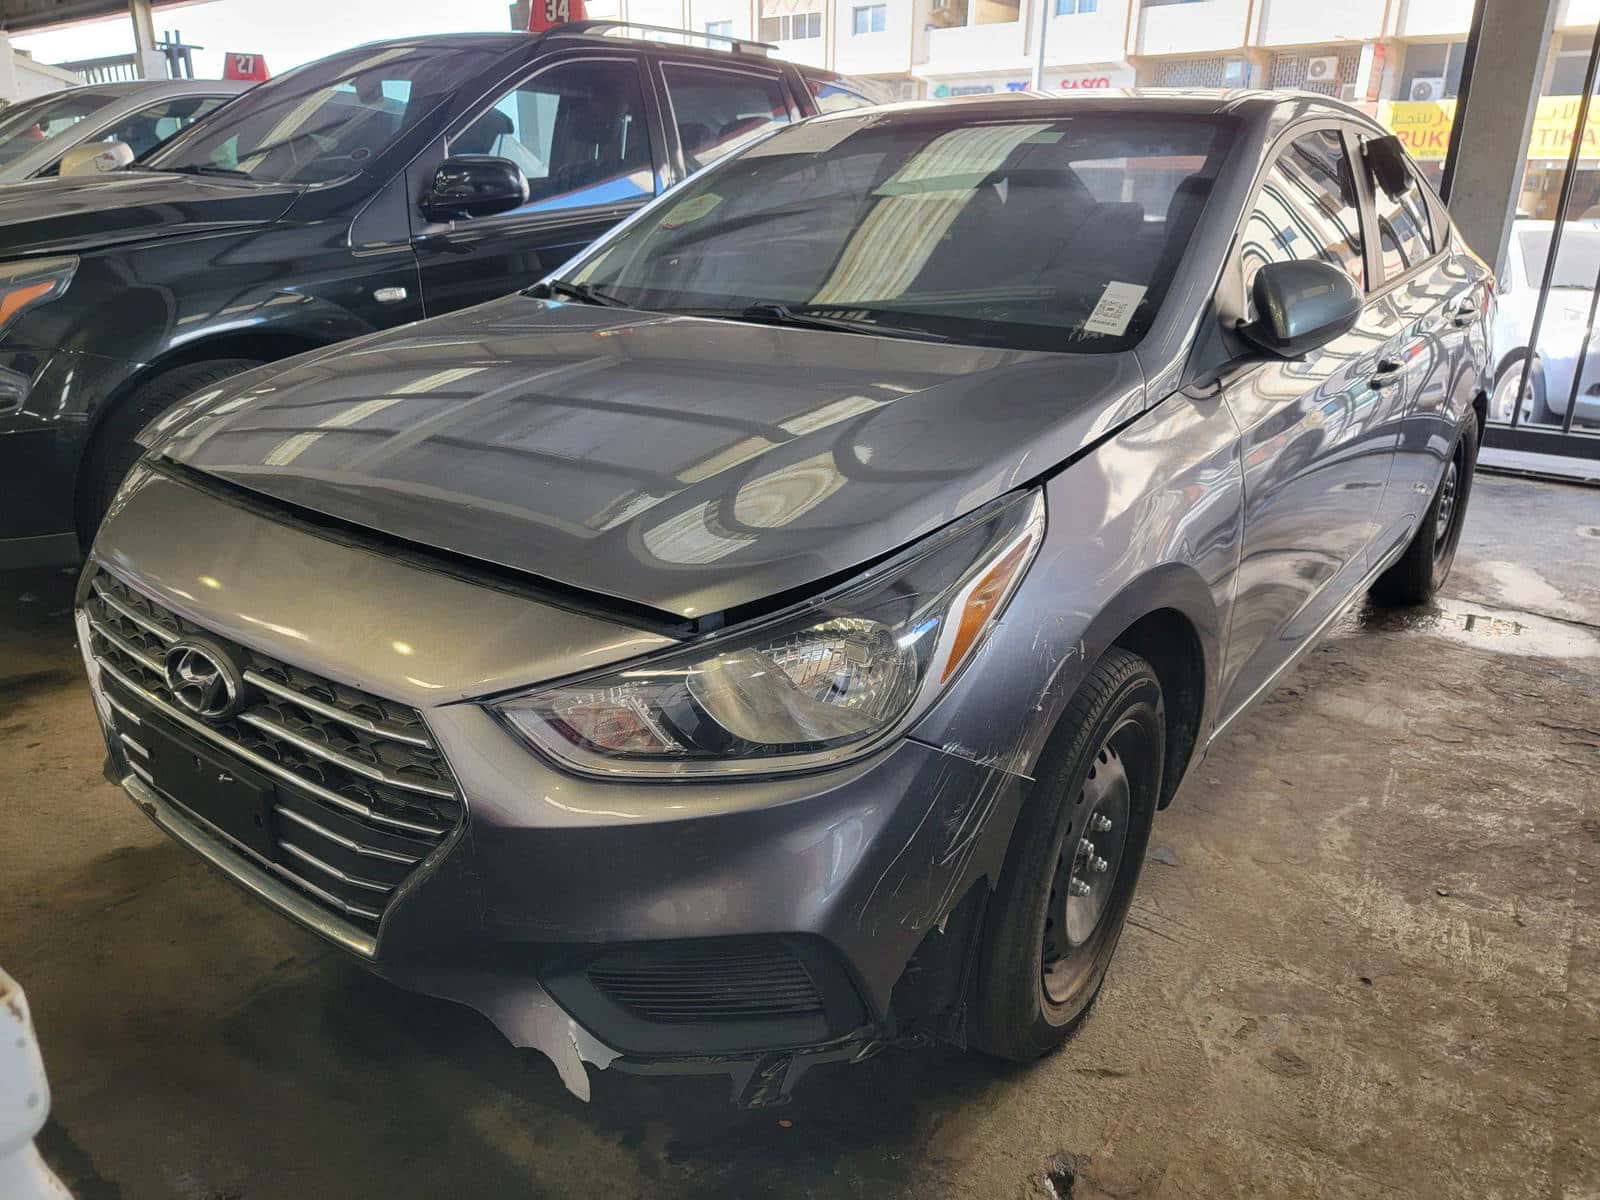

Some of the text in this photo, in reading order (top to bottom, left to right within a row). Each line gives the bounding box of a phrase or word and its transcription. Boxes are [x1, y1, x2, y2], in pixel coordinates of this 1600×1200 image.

[545, 0, 569, 22] 34
[236, 54, 254, 74] 27
[1395, 128, 1451, 148] RUK
